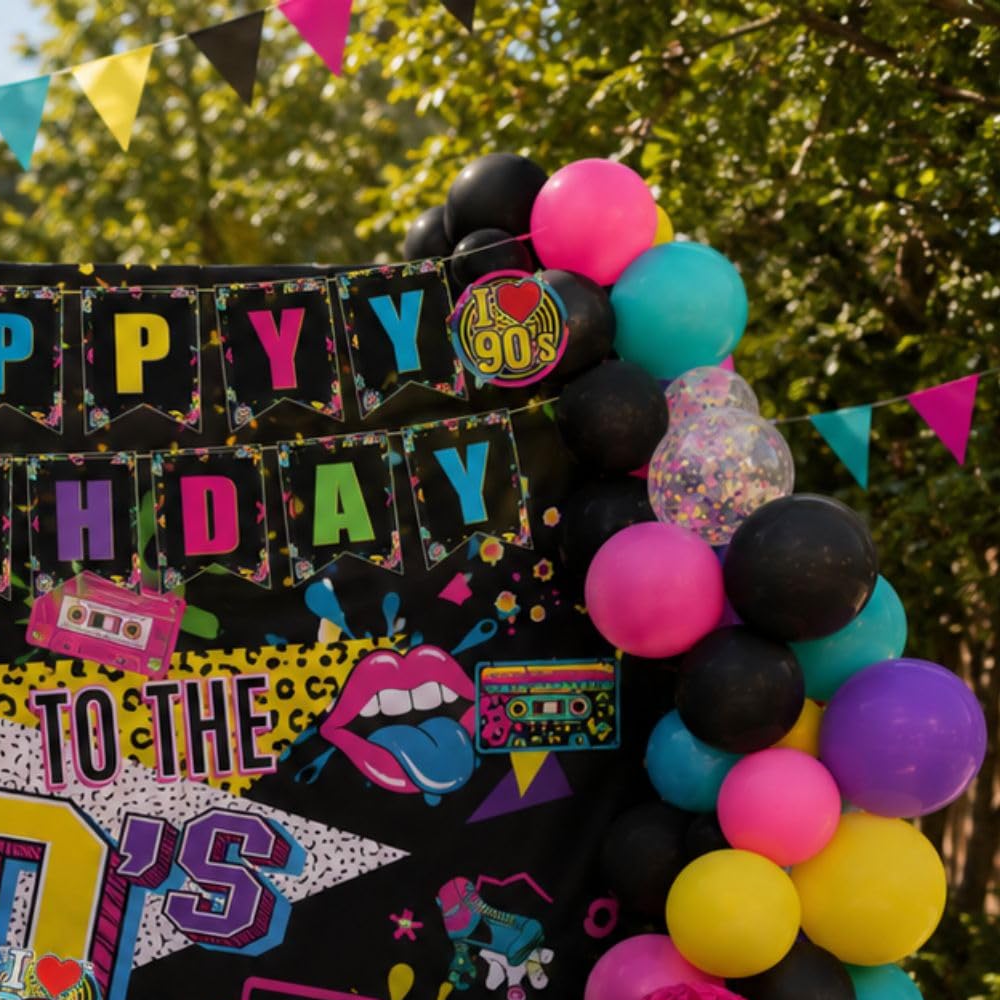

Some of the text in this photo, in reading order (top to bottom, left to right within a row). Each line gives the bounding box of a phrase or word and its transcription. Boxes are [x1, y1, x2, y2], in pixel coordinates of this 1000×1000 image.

[472, 287, 493, 328] I
[32, 683, 122, 788] TO
[144, 672, 276, 783] THE
